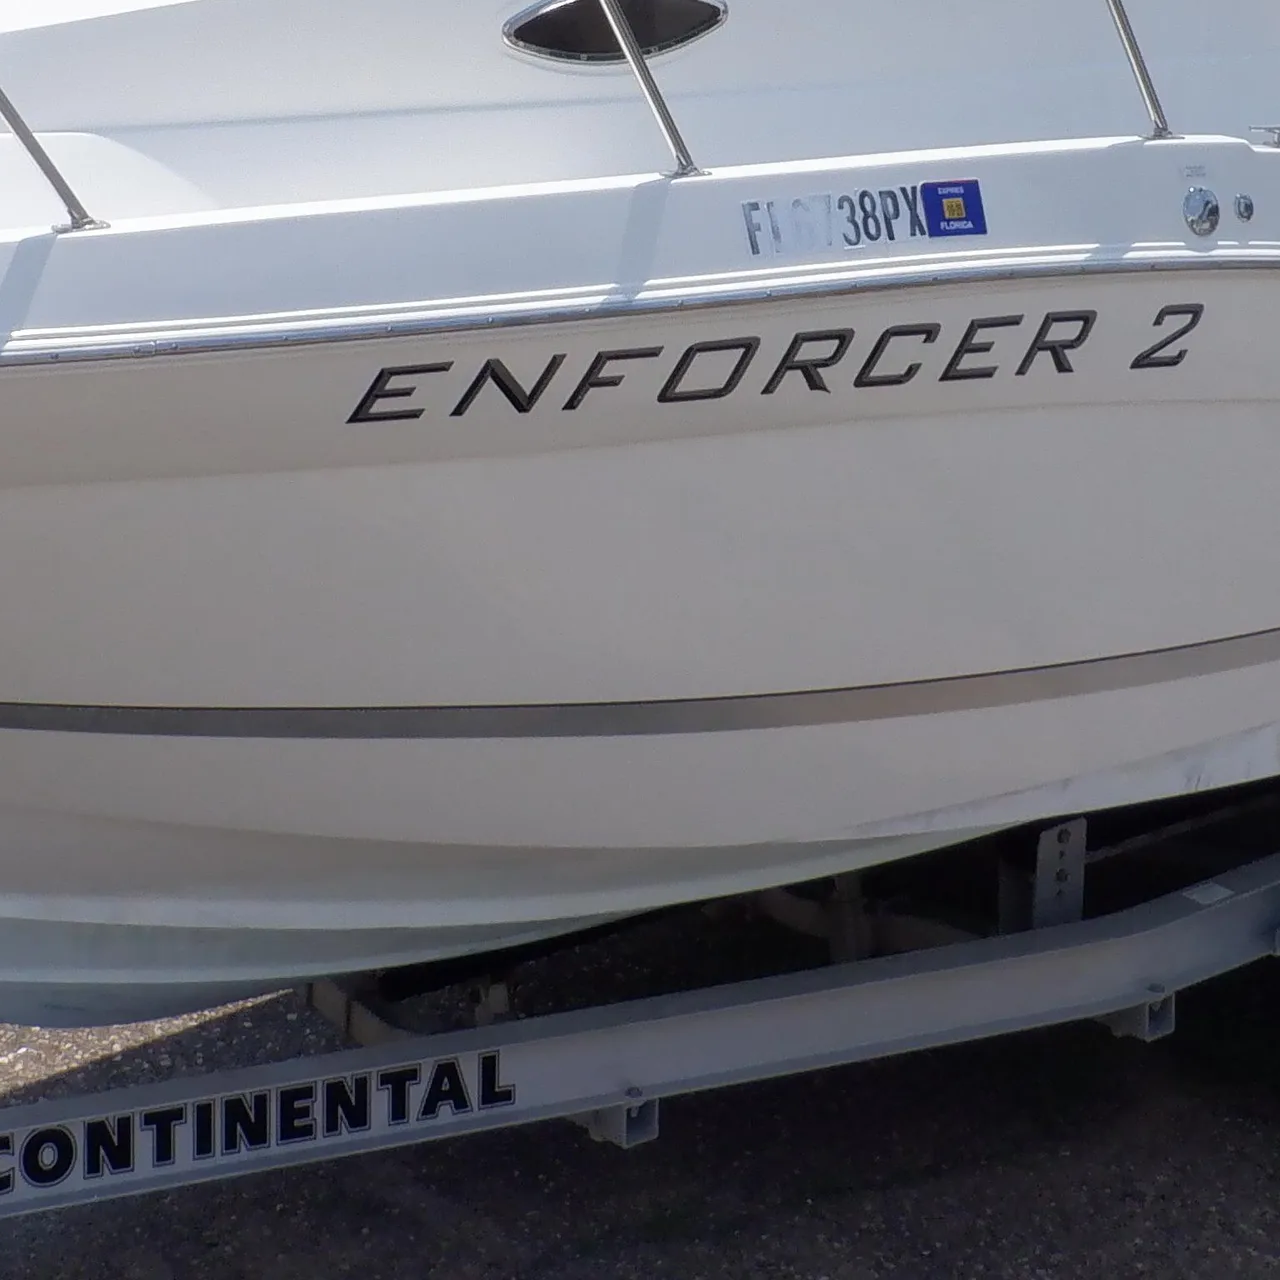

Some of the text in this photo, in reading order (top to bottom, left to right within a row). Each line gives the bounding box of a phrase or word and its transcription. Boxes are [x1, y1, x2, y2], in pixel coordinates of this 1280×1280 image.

[742, 186, 927, 256] F38PX
[940, 220, 974, 230] FLORIDA
[346, 303, 1204, 424] ENFORCER 2
